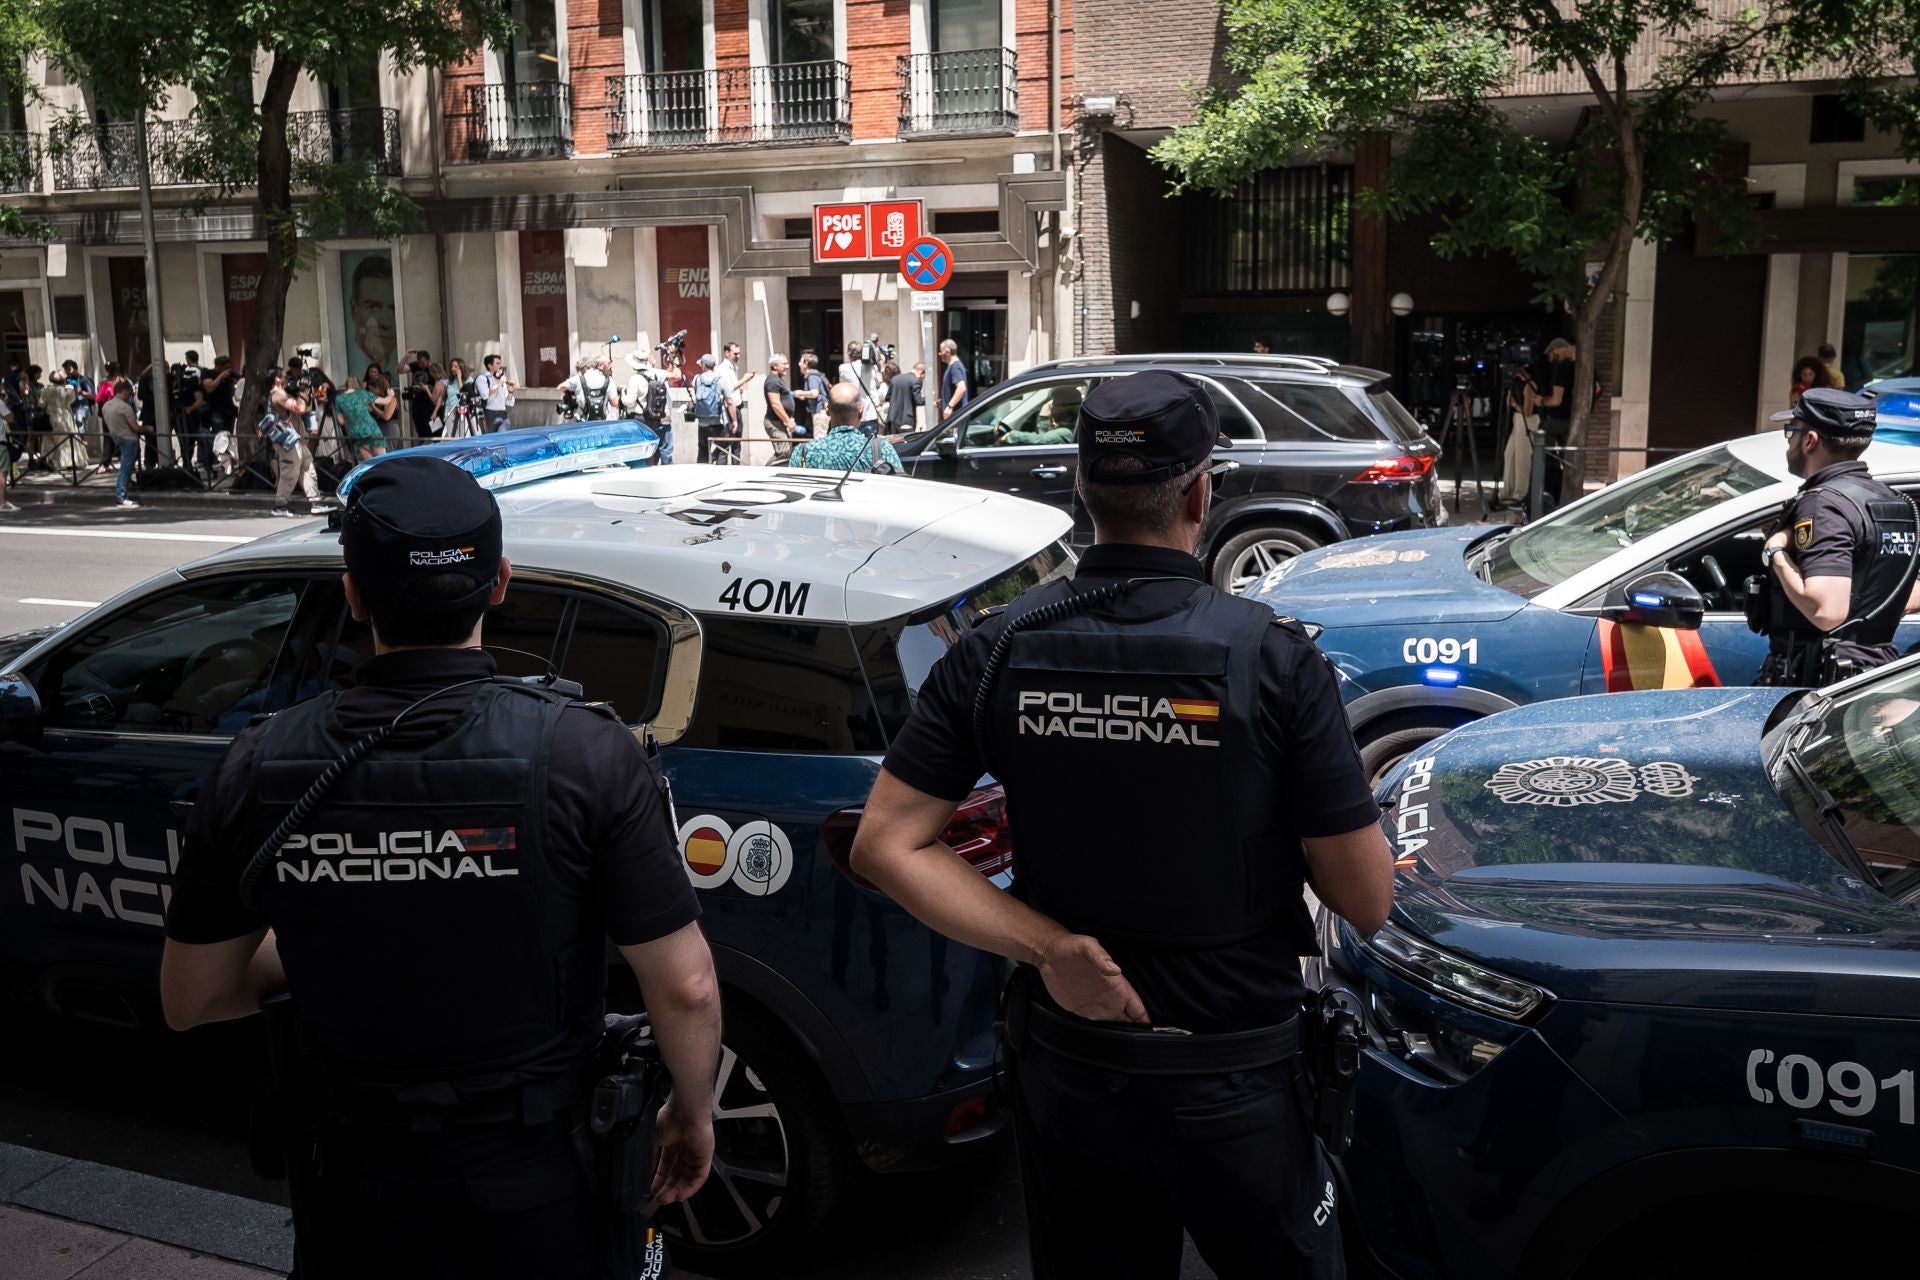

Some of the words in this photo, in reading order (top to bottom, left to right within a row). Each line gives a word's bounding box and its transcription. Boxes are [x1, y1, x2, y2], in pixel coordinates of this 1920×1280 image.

[822, 214, 862, 232] PSOE
[409, 553, 475, 566] NACIONAL
[1416, 637, 1478, 665] 091
[1018, 714, 1220, 747] NACIONAL
[276, 855, 519, 882] NACIONAL
[1776, 1054, 1915, 1125] 091
[1313, 1181, 1335, 1226] CNP
